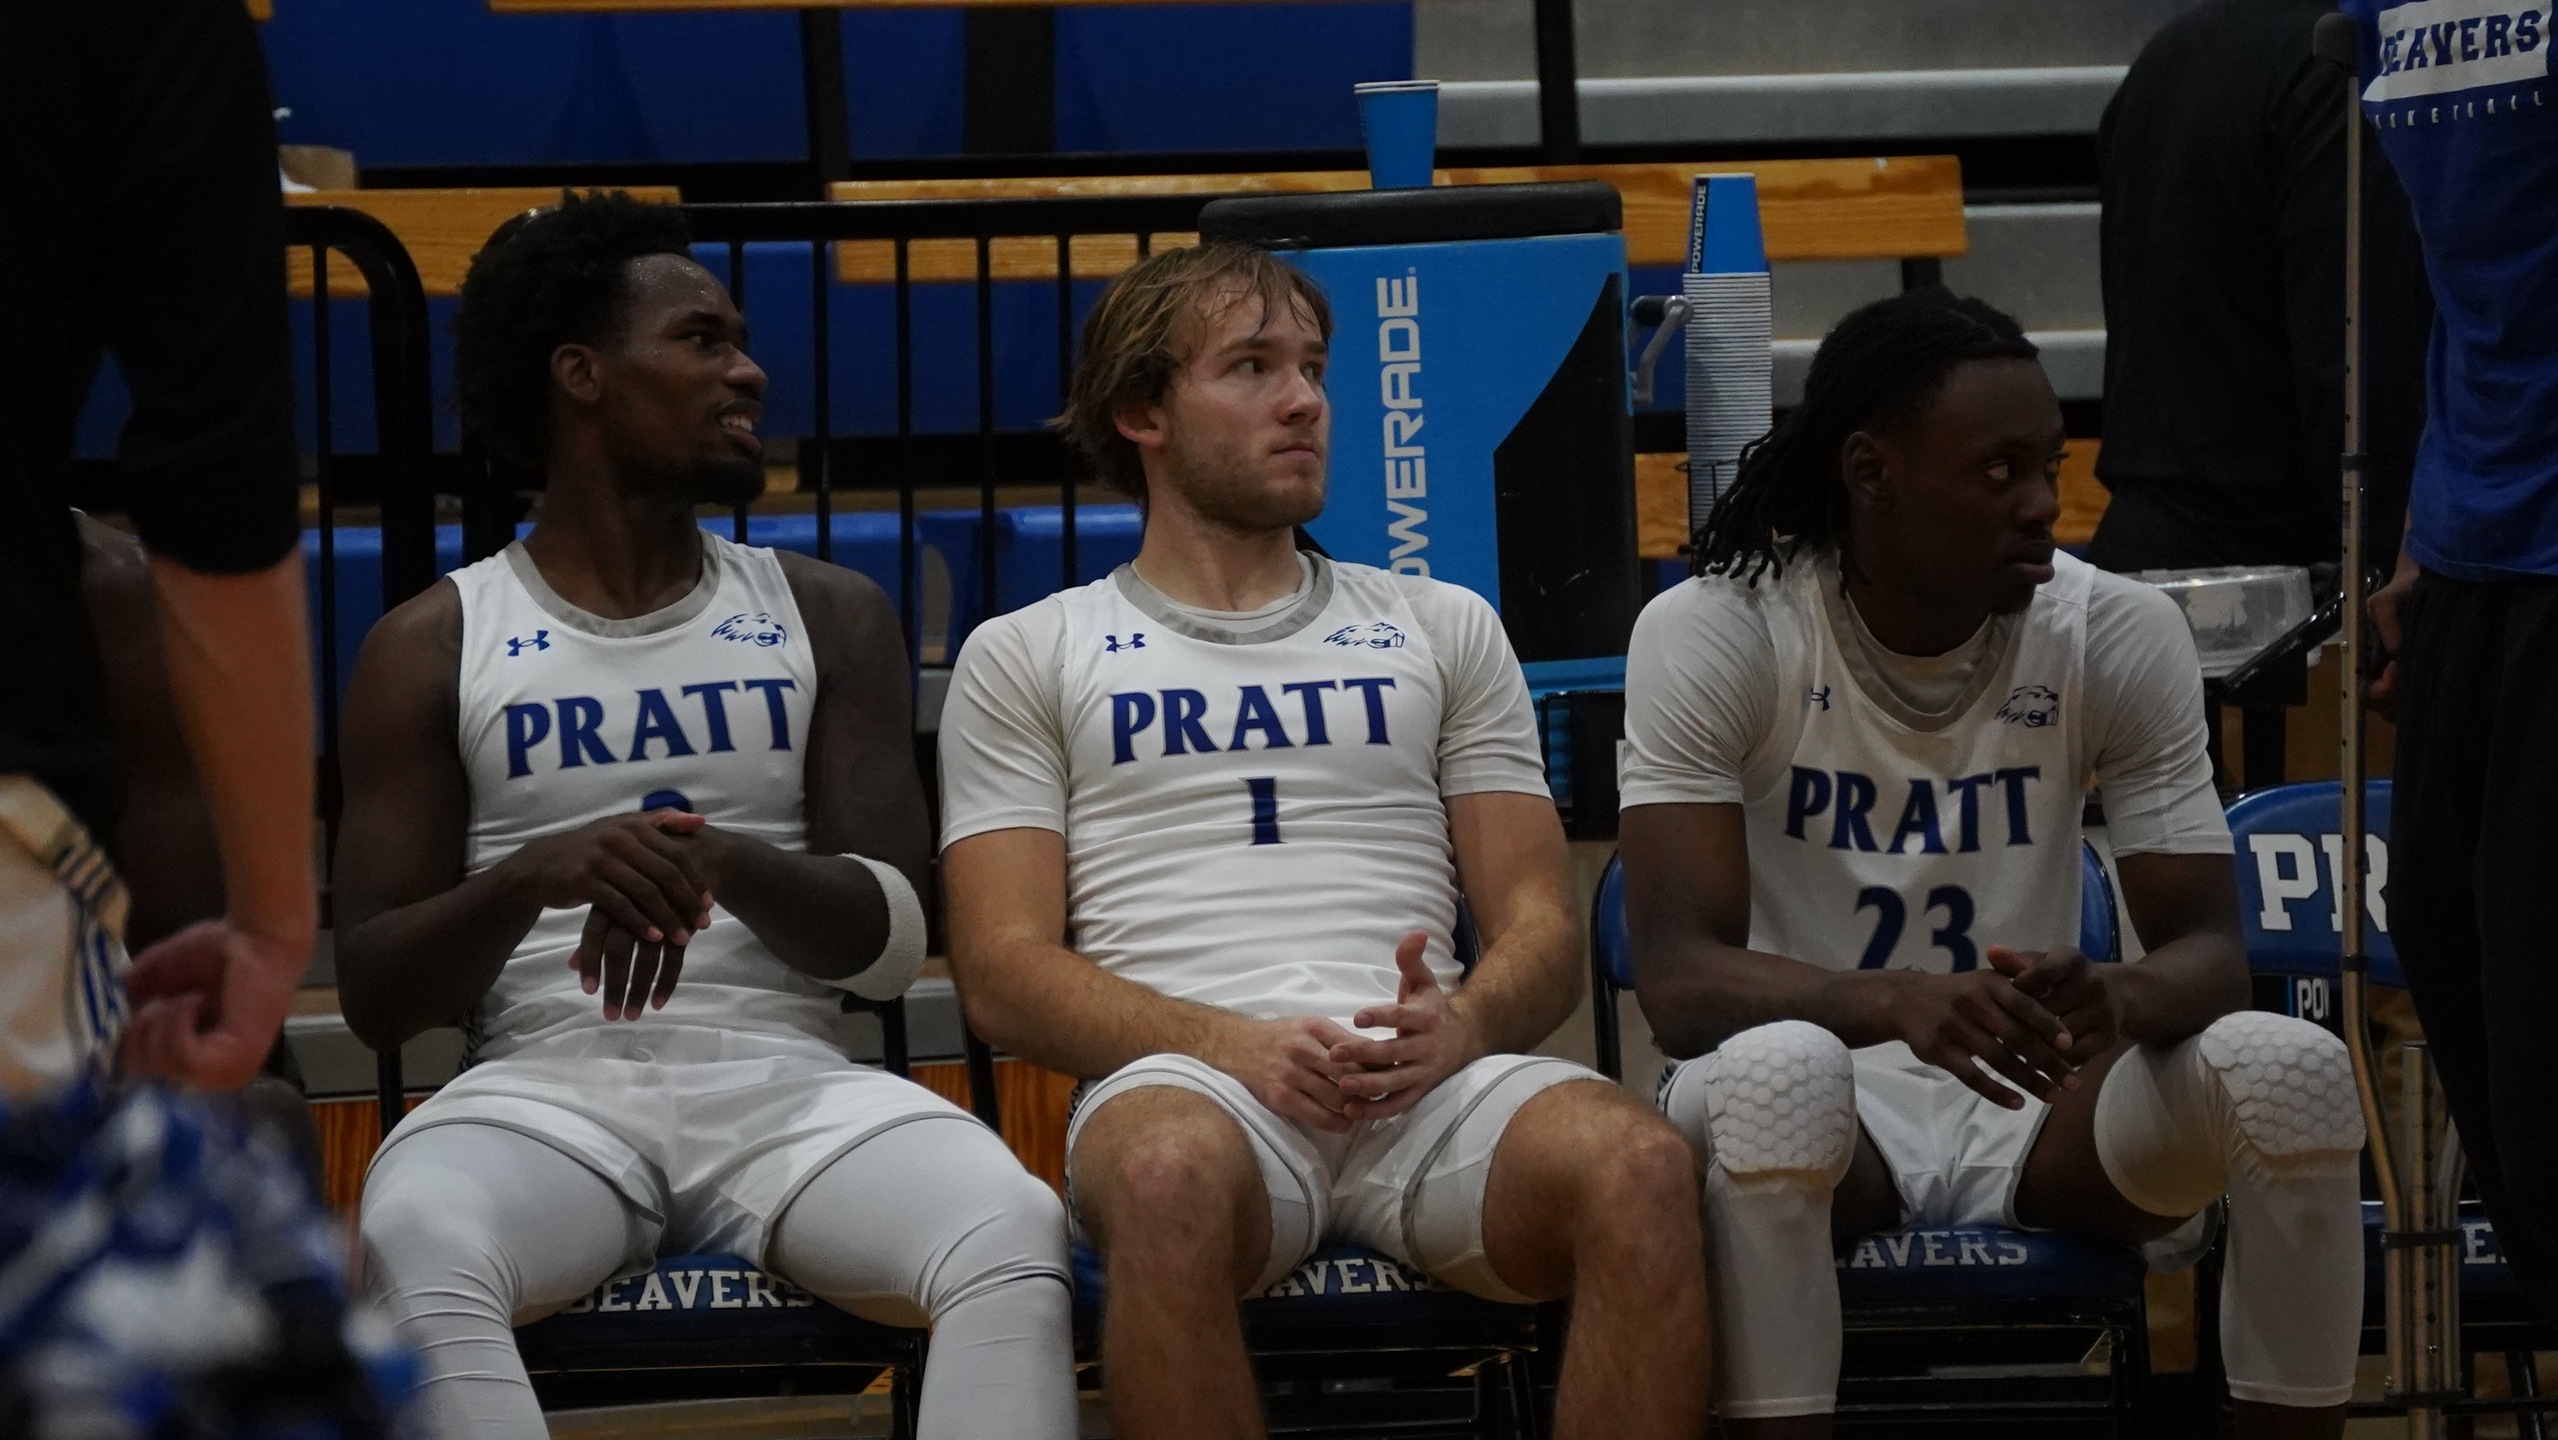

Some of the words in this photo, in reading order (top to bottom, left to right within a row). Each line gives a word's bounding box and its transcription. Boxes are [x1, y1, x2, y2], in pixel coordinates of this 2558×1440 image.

[1691, 184, 1707, 274] POWERADE
[504, 679, 796, 780] PRATT
[1109, 677, 1397, 767] PRATT
[1245, 777, 1288, 845] 1
[1785, 765, 2042, 855] PRATT
[1854, 884, 1977, 973] 23
[1836, 1230, 2029, 1269] AVERS
